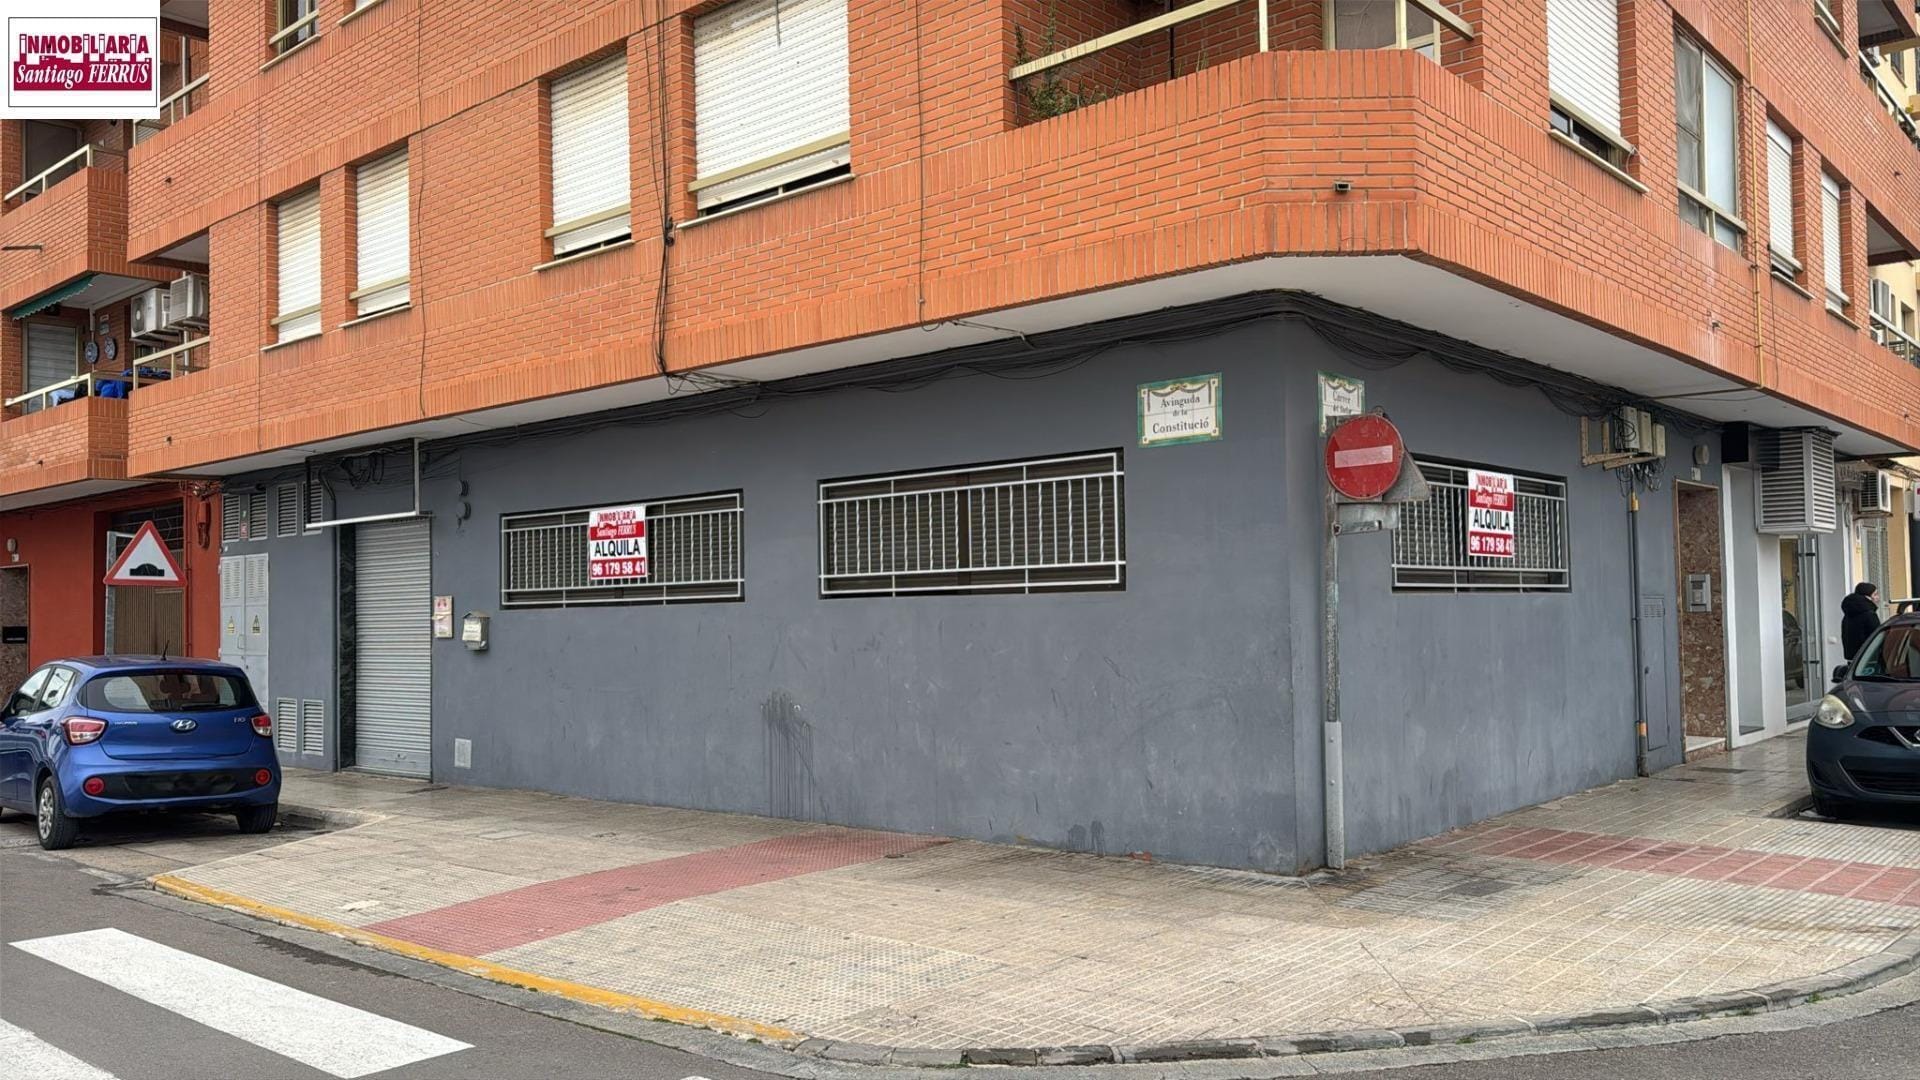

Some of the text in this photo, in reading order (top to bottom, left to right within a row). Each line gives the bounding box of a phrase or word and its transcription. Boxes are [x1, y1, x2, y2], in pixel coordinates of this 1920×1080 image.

[1160, 394, 1200, 408] Avinguda
[1152, 416, 1209, 434] Constitució
[1473, 508, 1510, 531] ALQUILA
[594, 538, 641, 557] ALQUILA
[1470, 535, 1480, 552] 96
[1481, 536, 1495, 552] 179
[1495, 537, 1505, 553] 58
[592, 561, 645, 576] 96 179 58 41
